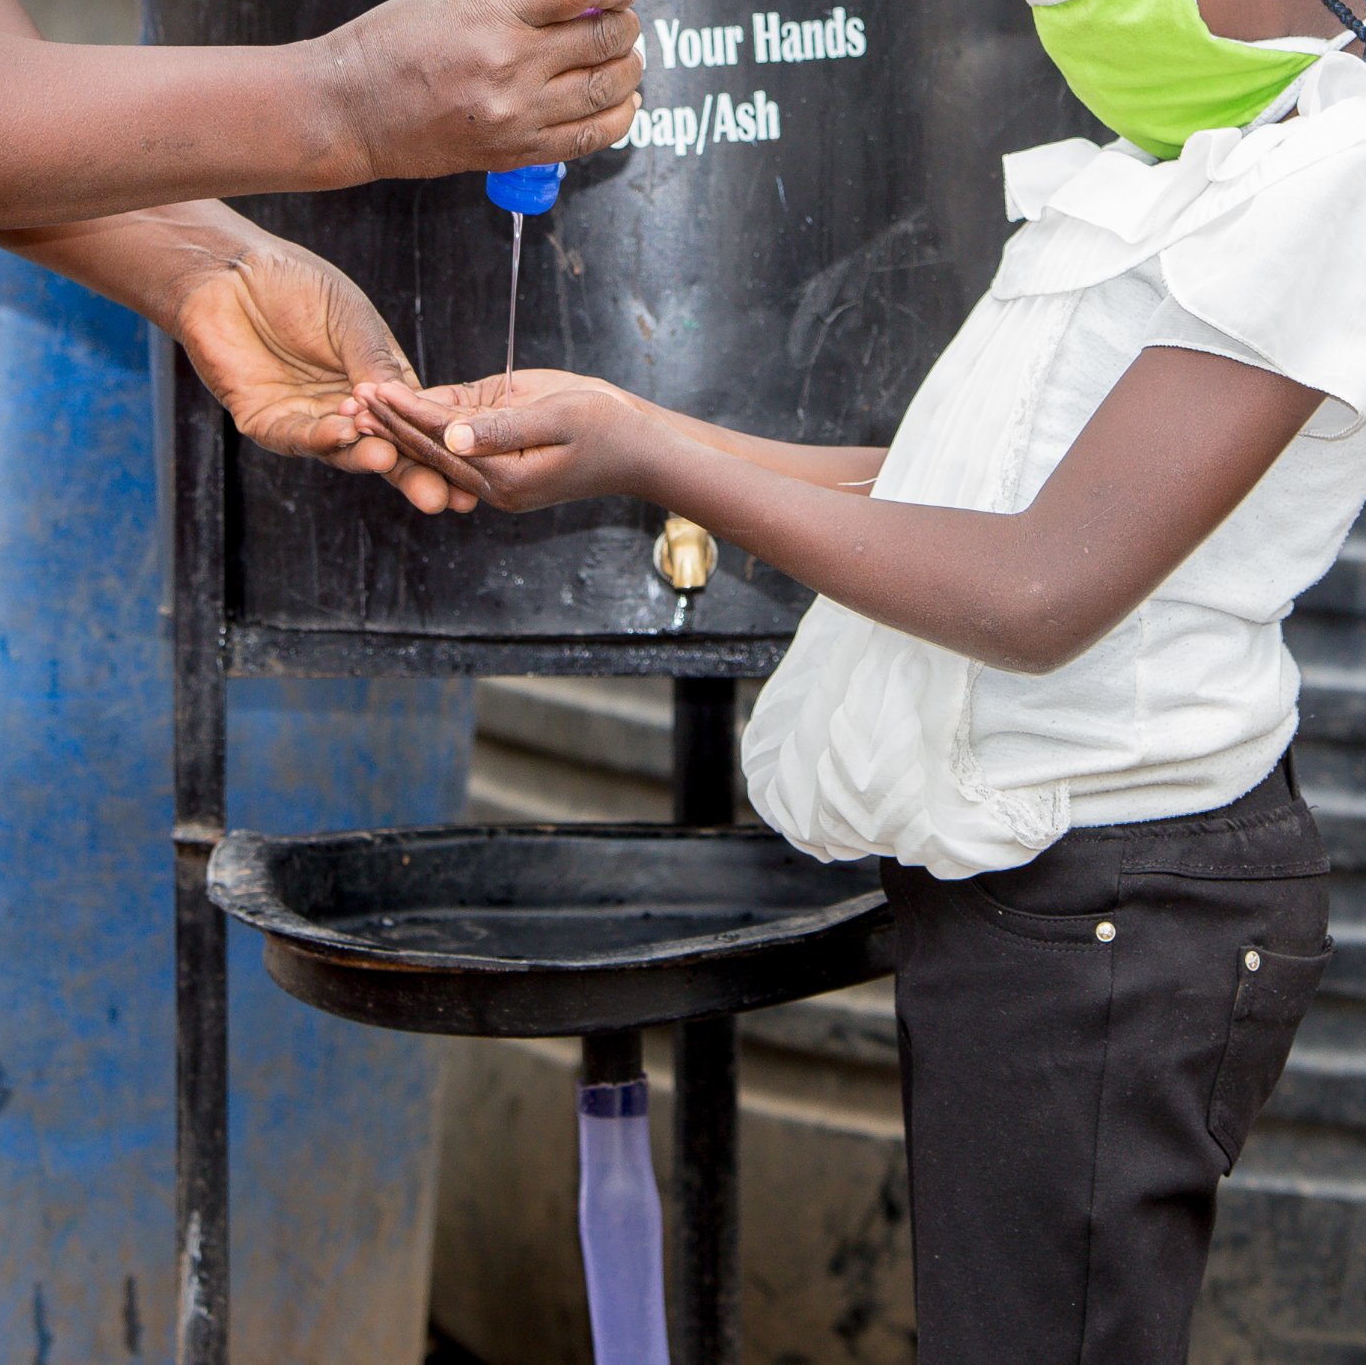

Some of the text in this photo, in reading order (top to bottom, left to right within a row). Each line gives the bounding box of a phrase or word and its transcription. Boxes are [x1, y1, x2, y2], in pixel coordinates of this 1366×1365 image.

[654, 17, 744, 70] Your
[751, 6, 867, 64] Hands
[611, 90, 782, 157] oap/Ash
